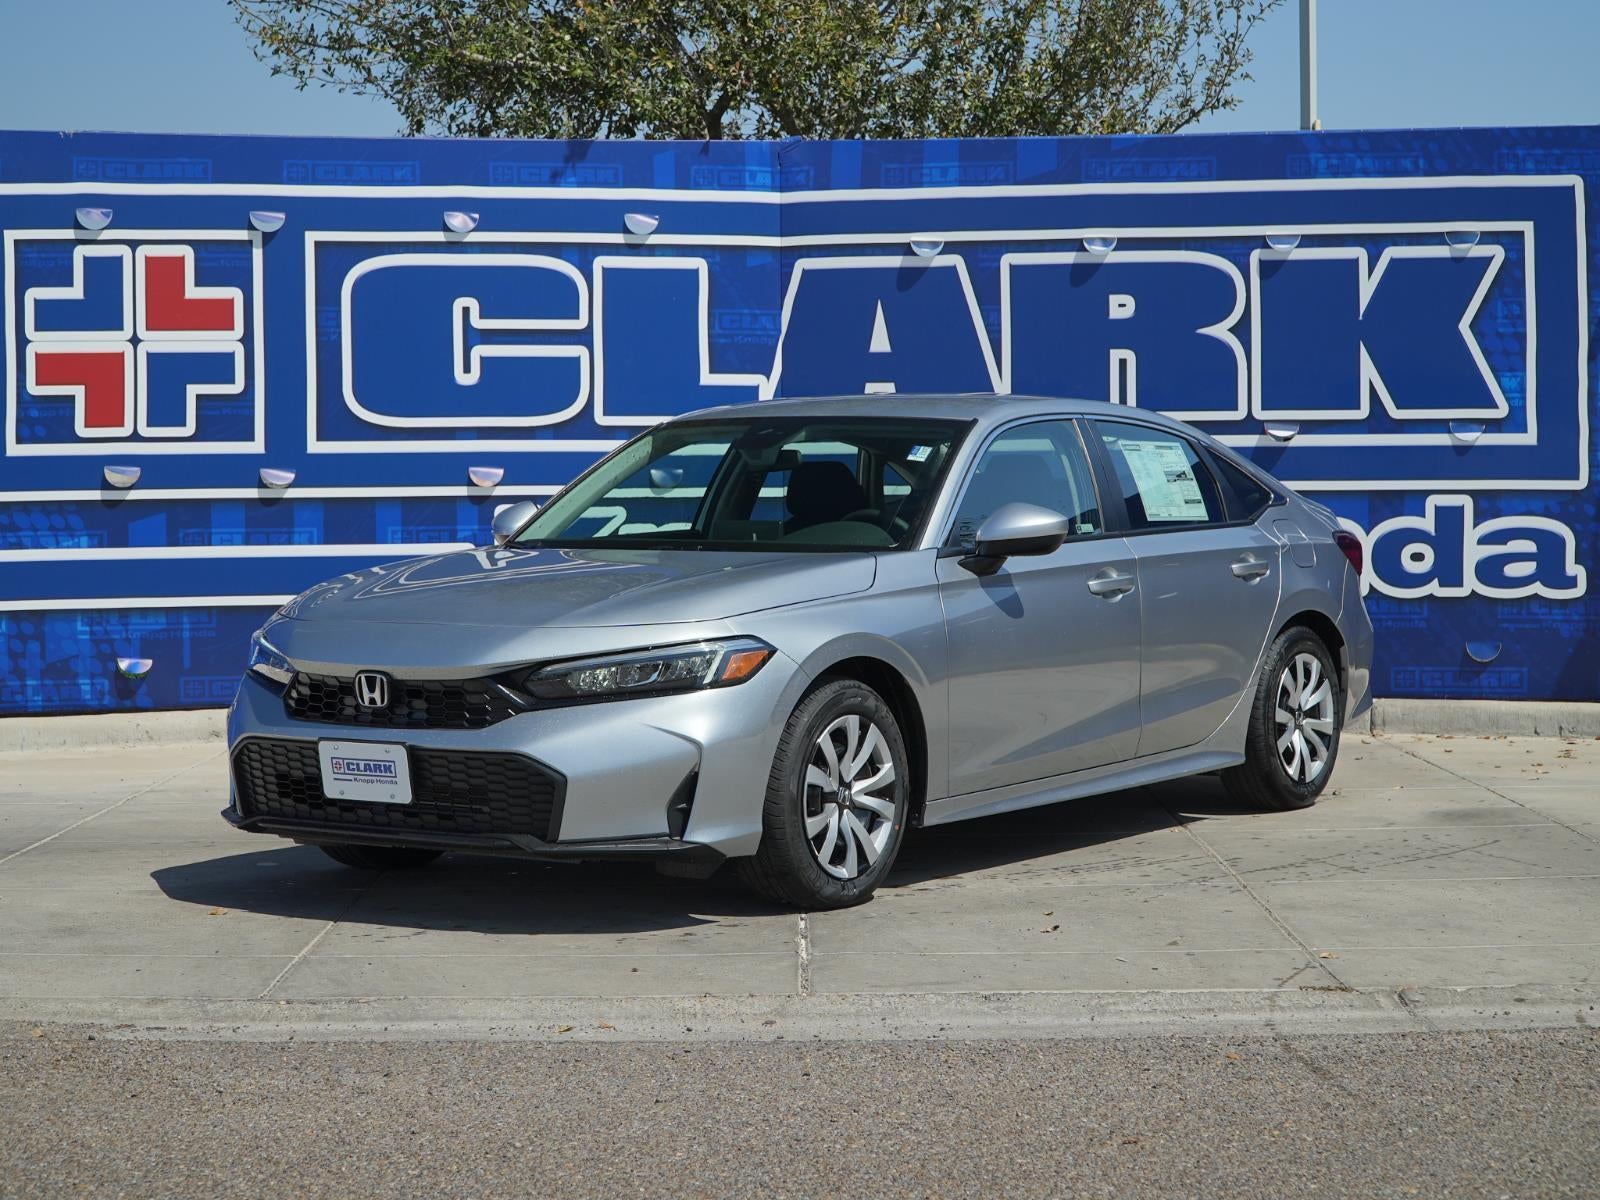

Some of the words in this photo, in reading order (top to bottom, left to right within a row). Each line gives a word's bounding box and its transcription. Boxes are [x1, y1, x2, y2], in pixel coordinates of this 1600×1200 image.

[341, 245, 1509, 427] CLARK
[345, 761, 394, 775] CLARK
[353, 777, 375, 785] Knapp
[376, 778, 398, 786] Honda
